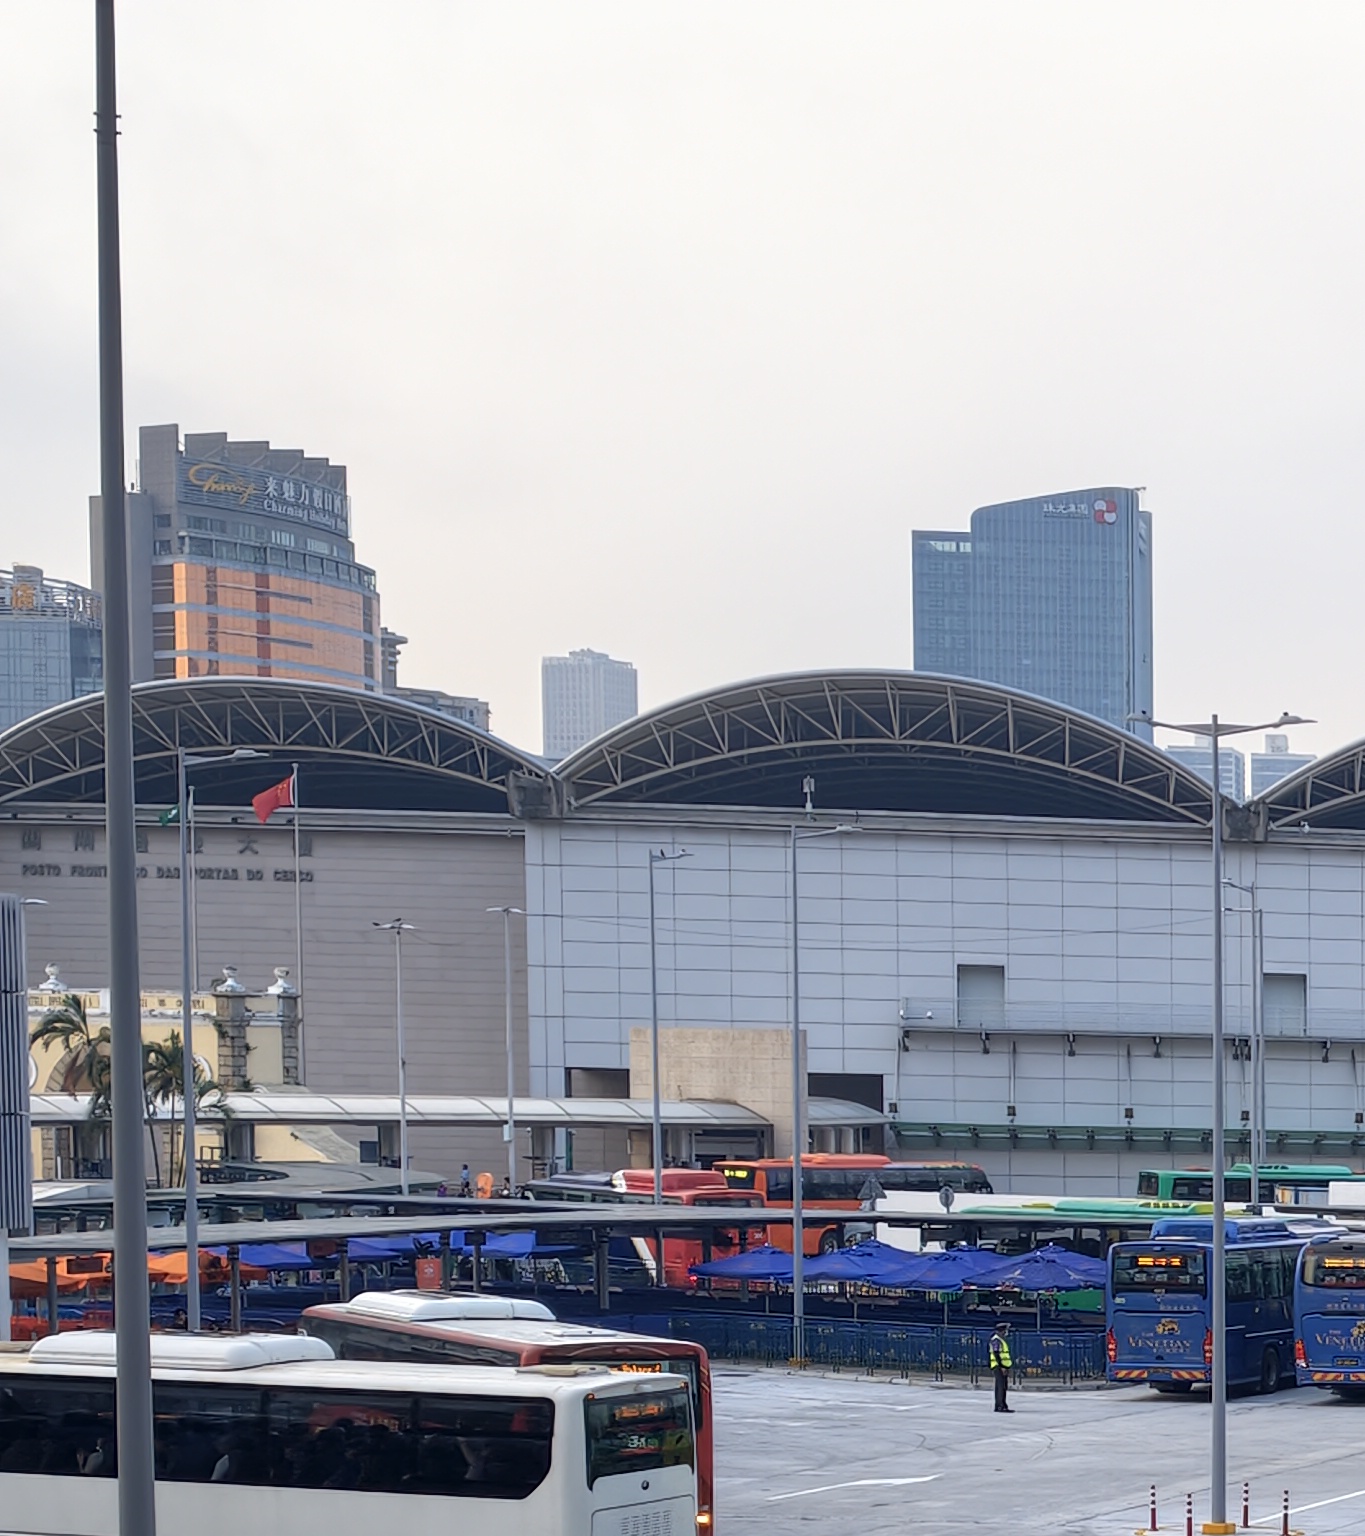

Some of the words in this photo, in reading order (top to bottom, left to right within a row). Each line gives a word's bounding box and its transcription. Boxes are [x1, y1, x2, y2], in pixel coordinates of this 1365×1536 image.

[22, 864, 61, 877] POSTO
[71, 865, 148, 879] FRONTO
[156, 866, 181, 880] DAS
